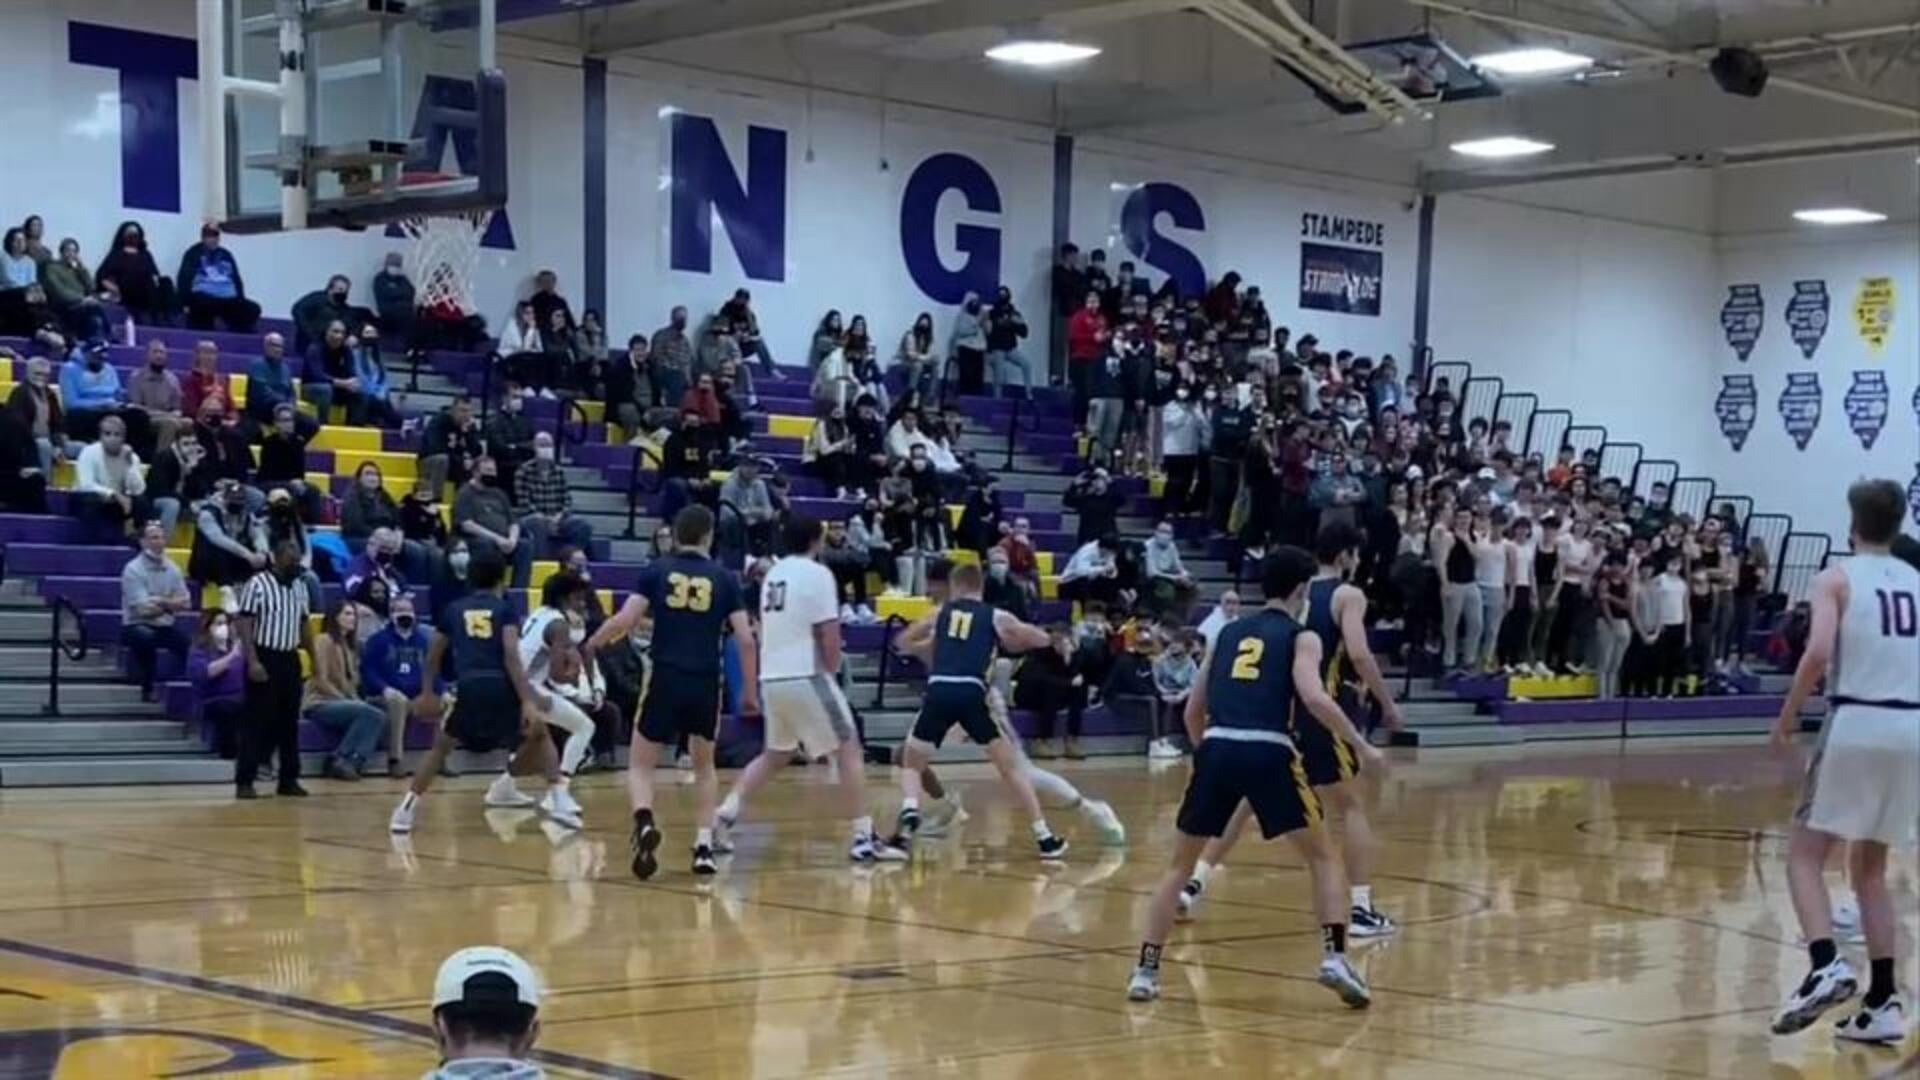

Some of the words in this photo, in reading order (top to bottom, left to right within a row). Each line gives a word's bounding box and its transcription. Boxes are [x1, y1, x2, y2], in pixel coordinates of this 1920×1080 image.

[1300, 211, 1385, 247] STAMPEDE
[665, 571, 713, 612] 33
[463, 609, 494, 640] 15
[947, 609, 974, 641] 11
[1874, 588, 1917, 637] 10
[1231, 636, 1265, 681] 2
